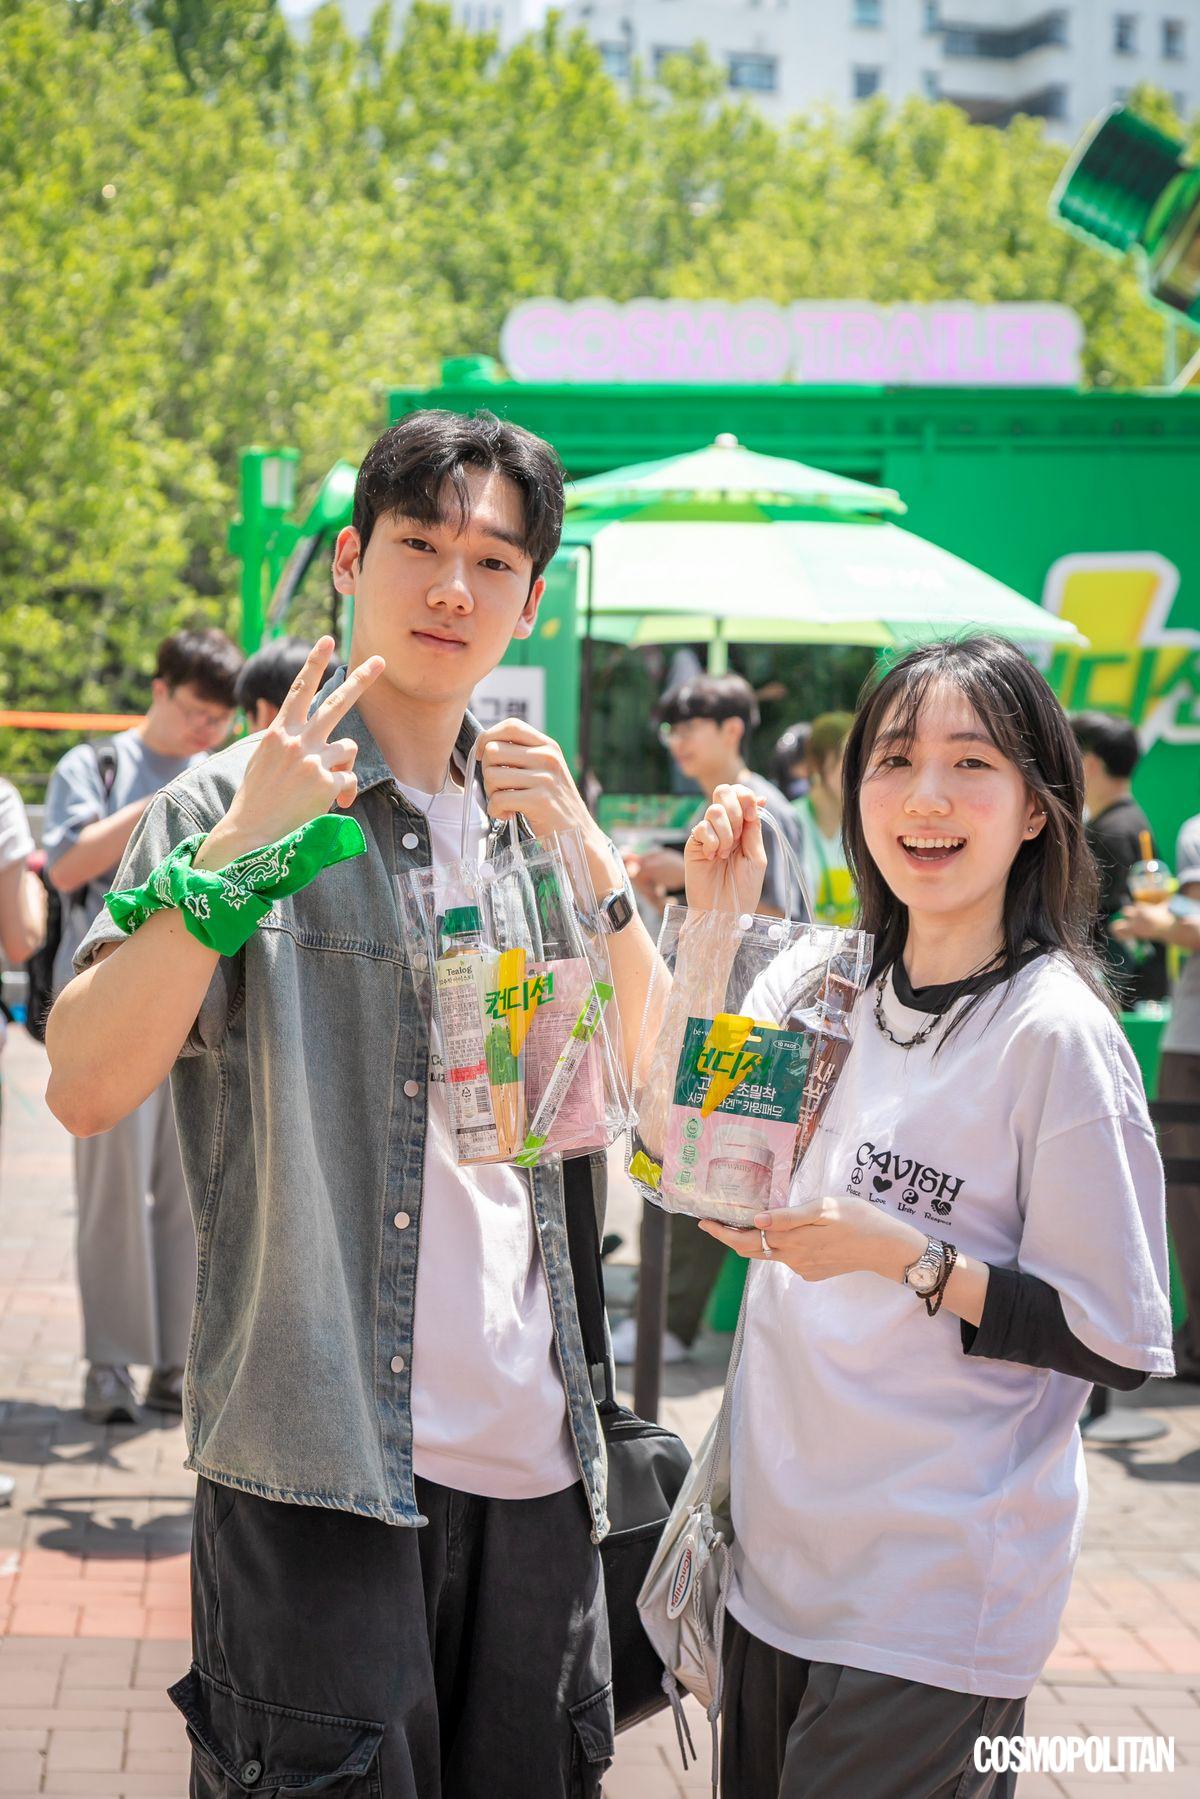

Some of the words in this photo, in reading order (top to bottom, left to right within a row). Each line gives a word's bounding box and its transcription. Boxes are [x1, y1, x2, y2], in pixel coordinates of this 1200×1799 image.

[510, 308, 787, 378] COSMO
[796, 311, 1077, 379] TRAILER
[446, 965, 473, 976] Tealog
[485, 972, 555, 1019] 컨디션
[737, 1082, 777, 1102] 초밀착
[742, 1100, 785, 1117] 카밍패드
[856, 1142, 965, 1202] CAVISH
[846, 1184, 862, 1197] Peace
[868, 1193, 887, 1205] Love
[897, 1202, 917, 1215] Unity
[924, 1210, 952, 1226] Respect
